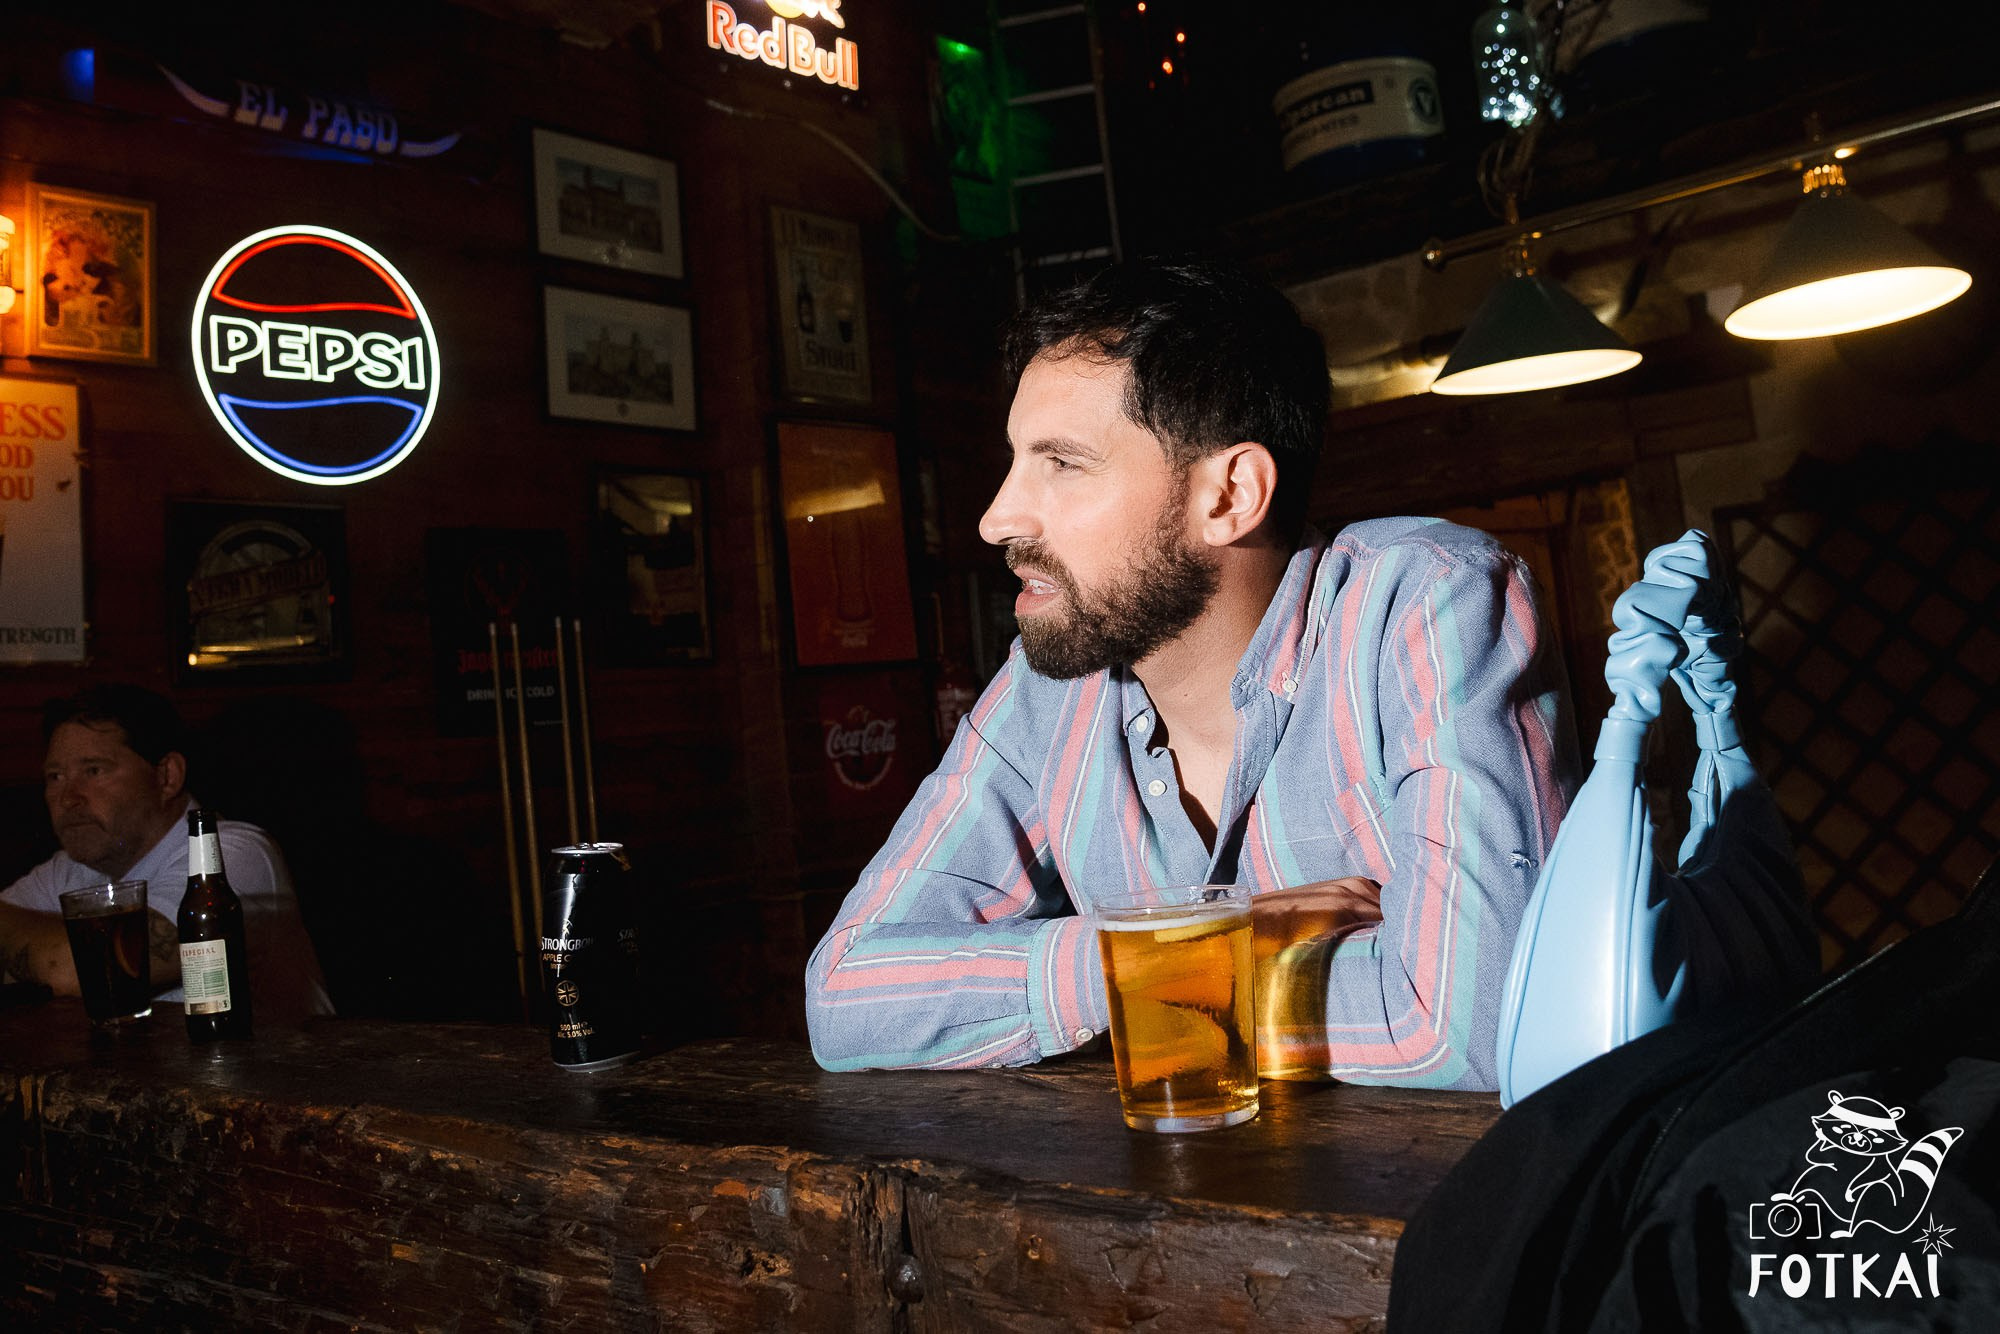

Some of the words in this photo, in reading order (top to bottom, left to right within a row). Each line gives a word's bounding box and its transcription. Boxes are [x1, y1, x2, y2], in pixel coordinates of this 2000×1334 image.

[706, 0, 787, 69] Red
[788, 24, 859, 91] Bull
[234, 80, 288, 131] EL
[302, 97, 399, 155] PASO
[209, 314, 426, 390] PEPSI
